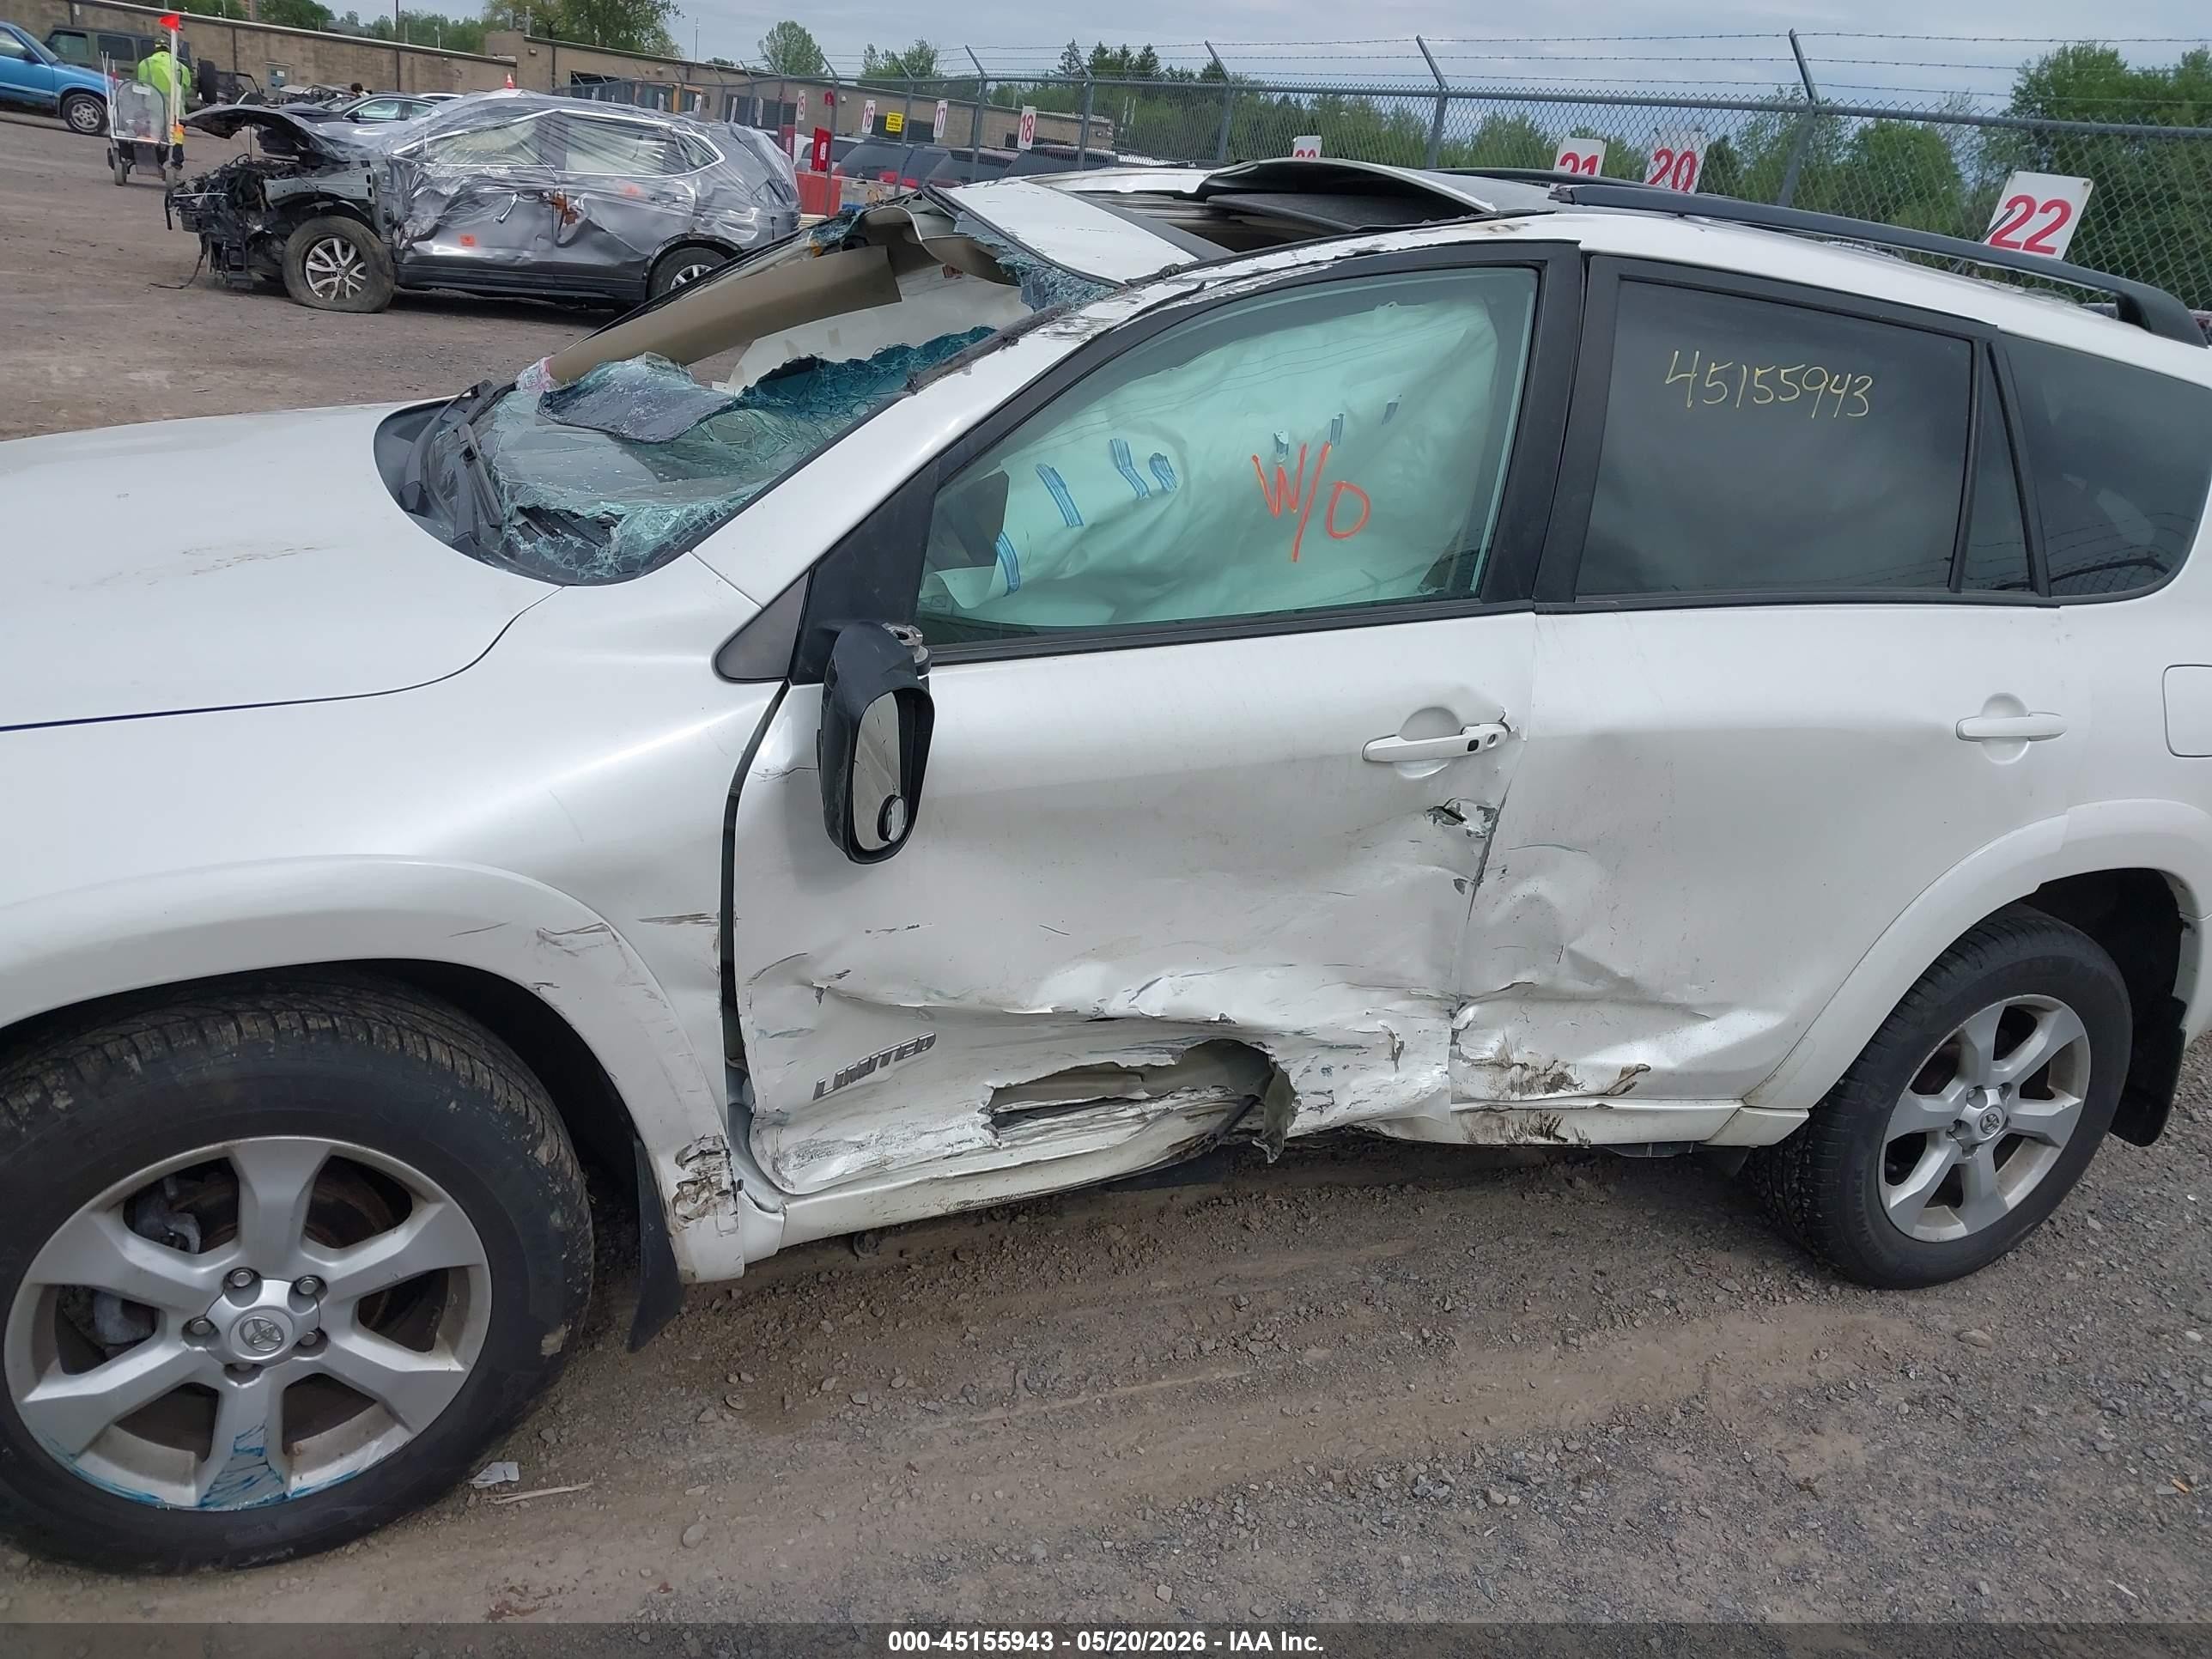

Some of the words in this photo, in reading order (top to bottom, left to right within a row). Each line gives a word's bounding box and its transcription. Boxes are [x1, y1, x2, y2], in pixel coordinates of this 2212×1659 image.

[796, 95, 805, 117] 15
[864, 106, 874, 128] 16
[936, 106, 946, 131] 17
[1021, 113, 1034, 143] 18
[1648, 148, 1697, 192] 20
[1990, 194, 2072, 255] 22
[1664, 349, 1874, 419] 45155943
[811, 1031, 937, 1100] LIMITED
